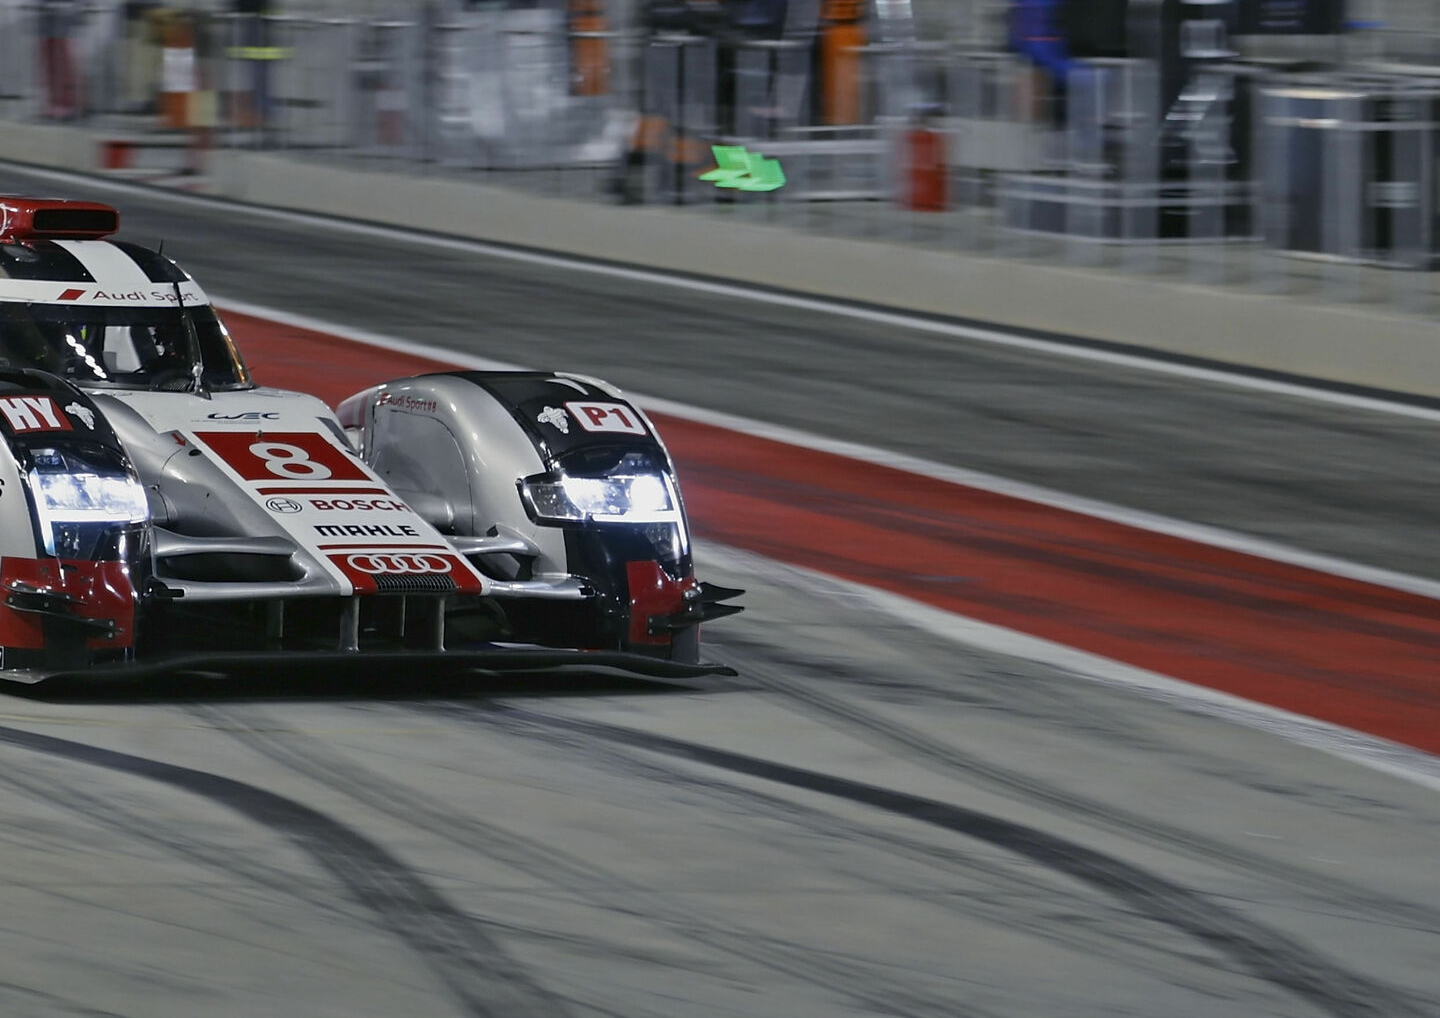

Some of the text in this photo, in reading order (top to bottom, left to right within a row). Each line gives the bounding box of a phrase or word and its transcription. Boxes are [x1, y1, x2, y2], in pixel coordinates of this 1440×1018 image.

[92, 290, 148, 301] Audi
[206, 411, 281, 420] WEC
[581, 406, 635, 429] P1
[248, 441, 333, 480] 8
[309, 499, 414, 514] BOSCH
[313, 525, 421, 537] MAHLE
